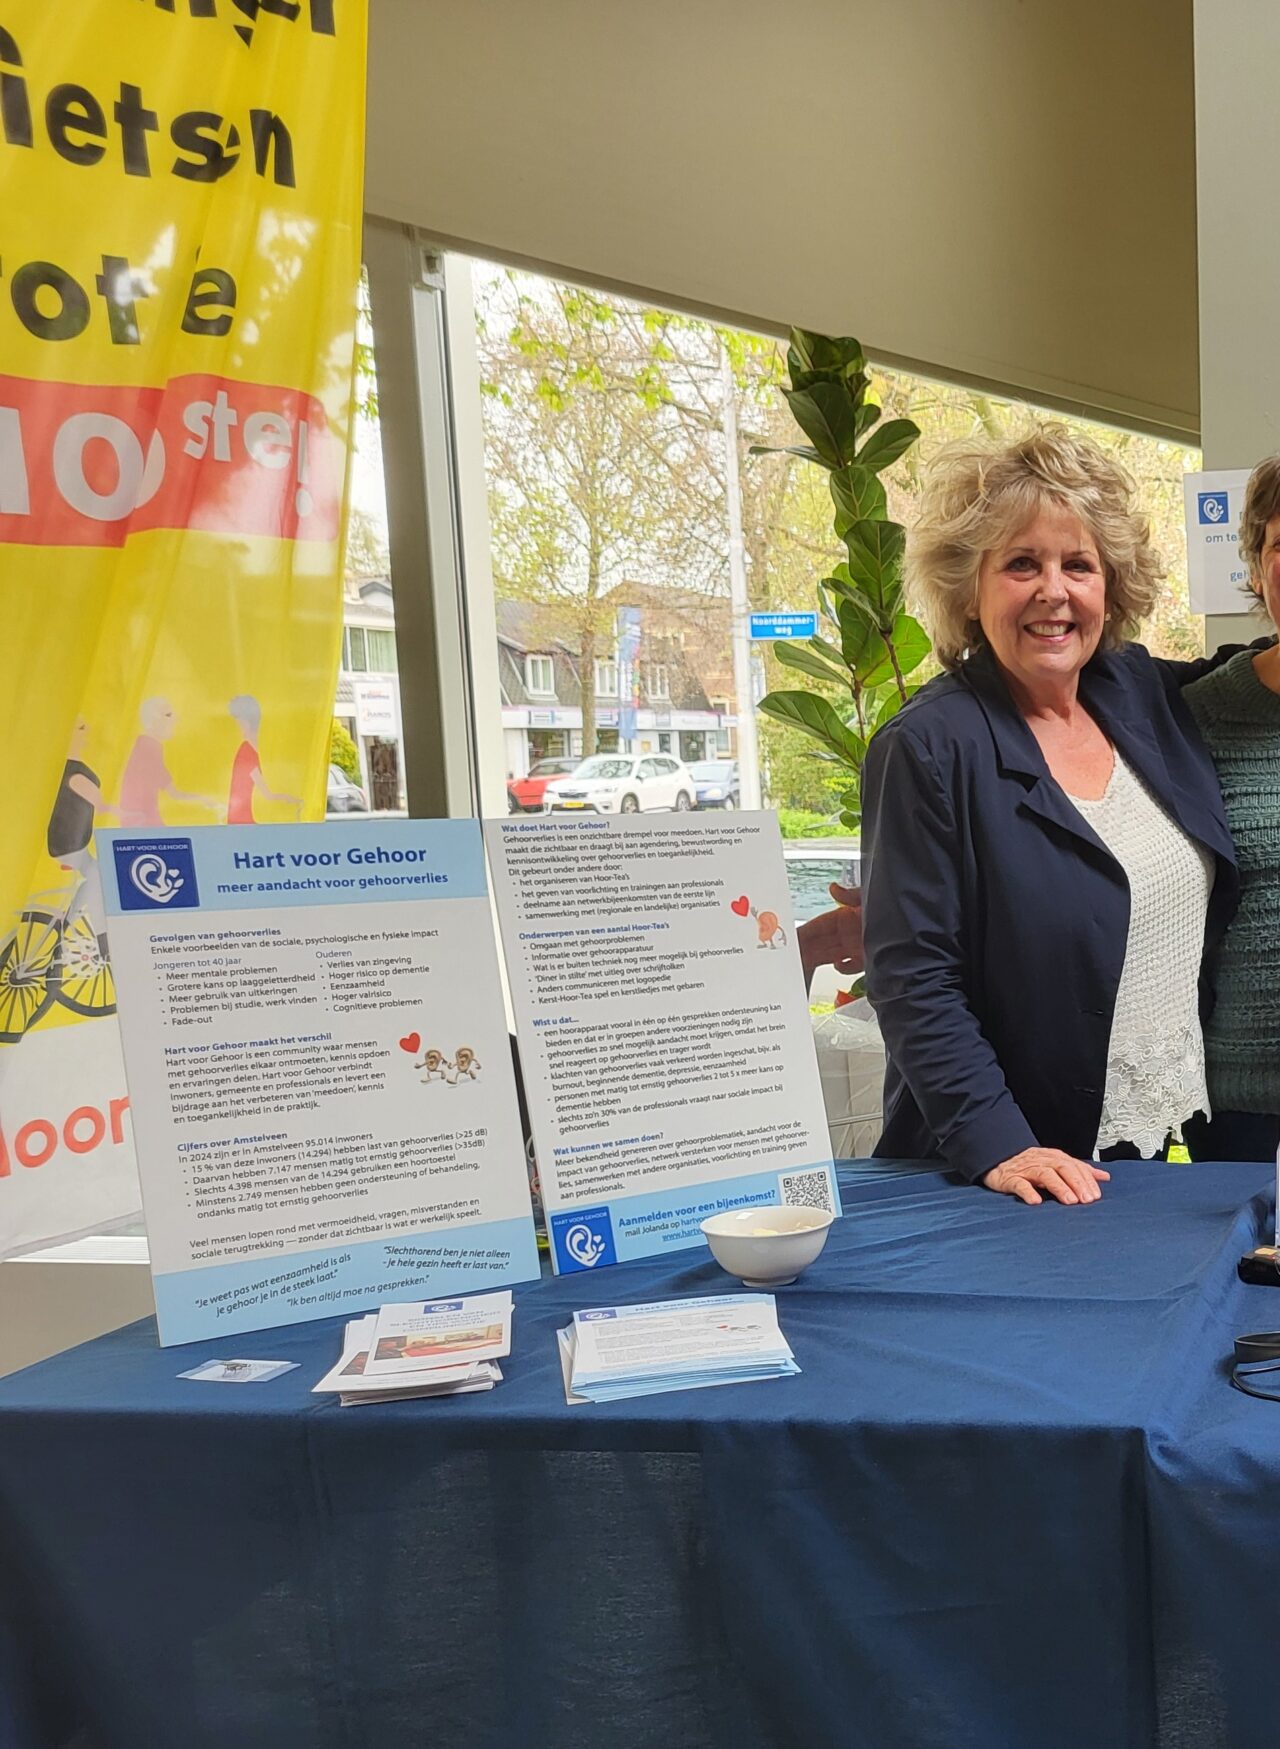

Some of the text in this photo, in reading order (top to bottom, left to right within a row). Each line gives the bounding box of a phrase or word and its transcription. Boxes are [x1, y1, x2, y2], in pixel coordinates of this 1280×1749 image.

[1205, 534, 1224, 543] om
[752, 616, 814, 626] Noorddammer-
[774, 626, 792, 636] weg
[578, 821, 610, 829] Gehoor?
[234, 846, 426, 869] Hart voor Gehoor
[217, 872, 448, 893] meer aandacht voor gehoorverlies
[149, 934, 196, 943] Gevolgen
[217, 928, 281, 940] gehoorverlies
[518, 930, 574, 940] Onderwerpen
[607, 924, 631, 933] aantal
[150, 945, 181, 954] Enkele
[182, 942, 239, 952] voorbeelden
[272, 938, 303, 947] sociale,
[305, 934, 368, 946] psychologische
[382, 931, 410, 941] fysieke
[411, 930, 438, 938] impact
[529, 942, 562, 950] Omgaan
[579, 935, 645, 947] gehoorproblemen
[315, 950, 352, 959] Ouderen
[531, 952, 570, 961] Informatie
[589, 945, 654, 958] gehoorapparatuur
[153, 961, 196, 970] Jongeren
[225, 958, 242, 966] jaar
[326, 960, 354, 968] Verlies
[372, 956, 412, 966] zingeving
[191, 969, 228, 978] mentale
[230, 966, 278, 977] problemen
[328, 972, 354, 980] Hoger
[392, 965, 430, 975] dementie
[167, 983, 201, 992] Grotere
[240, 973, 316, 987] laaggeletterdheid
[330, 979, 385, 990] Eenzaamheid
[194, 991, 228, 1003] gebruik
[248, 987, 297, 997] uitkeringen
[331, 990, 392, 1002] Hoger valrisico
[170, 996, 317, 1014] Problemen bij studie, werk vinden
[333, 999, 423, 1013] Cognitieve problemen
[172, 1016, 213, 1026] Fade-out
[164, 1047, 186, 1055] Hart
[212, 1042, 247, 1050] Gehoor
[249, 1038, 279, 1047] maakt
[297, 1032, 332, 1042] verschil
[177, 1142, 208, 1152] Cijfers
[233, 1133, 288, 1145] Amstelveen
[190, 1152, 212, 1162] 2024
[214, 1150, 230, 1160] zijn
[253, 1142, 304, 1154] Amstelveen
[305, 1137, 334, 1147] 95.014
[335, 1133, 373, 1143] inwoners
[553, 1147, 569, 1156] Wat
[570, 1143, 600, 1153] kunnen
[614, 1137, 640, 1146] samen
[641, 1132, 663, 1142] doen?
[618, 1189, 775, 1227] Aanmelden voor een bijeenkomst?
[625, 1227, 641, 1237] mail
[642, 1222, 669, 1234] Jolanda
[662, 1228, 703, 1242] www.hartv
